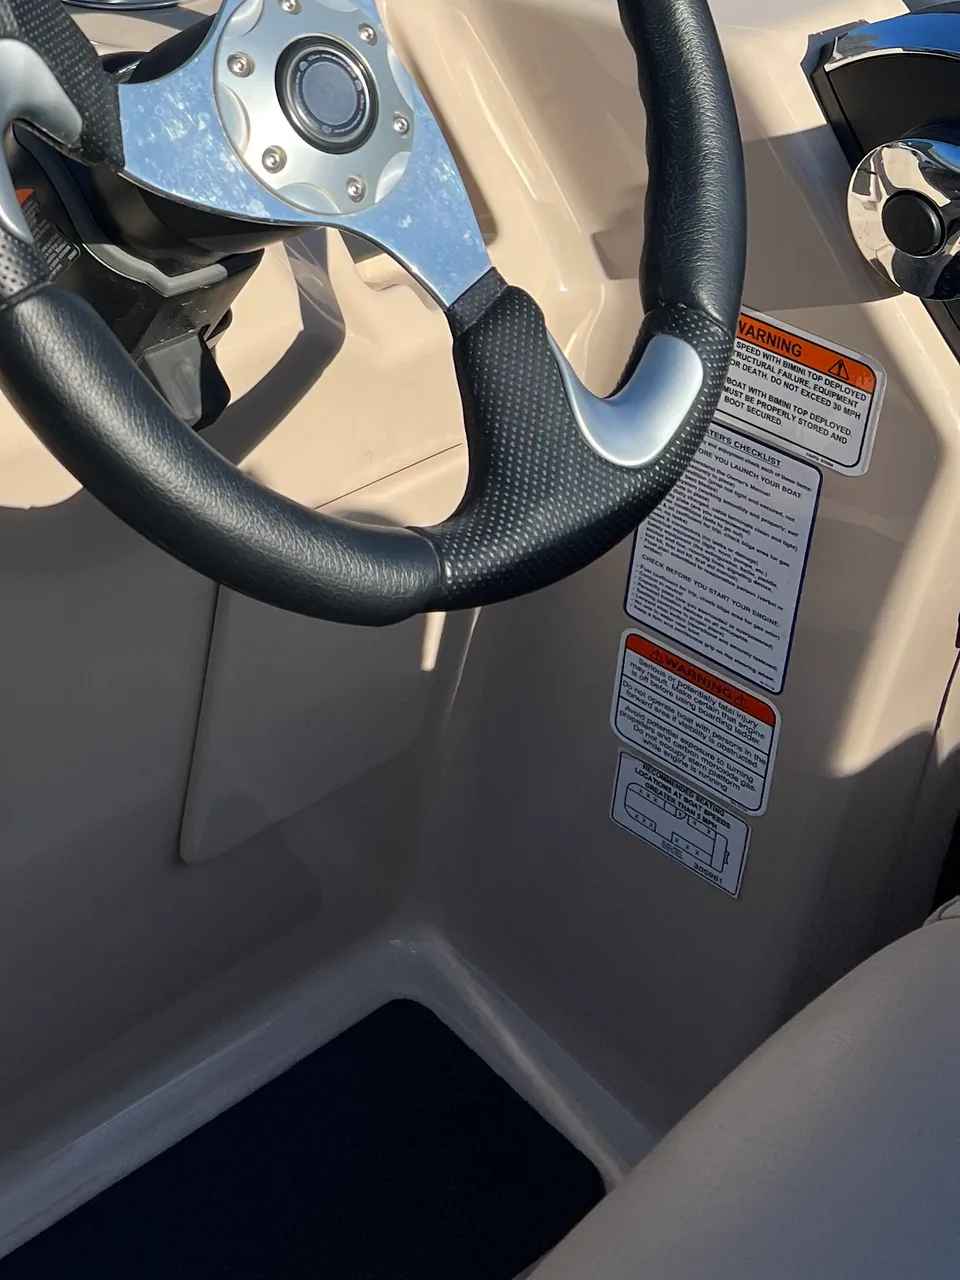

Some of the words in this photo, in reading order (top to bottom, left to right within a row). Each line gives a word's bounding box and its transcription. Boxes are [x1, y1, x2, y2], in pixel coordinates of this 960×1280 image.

[733, 350, 776, 373] TRUCTURAL
[778, 369, 811, 388] FAILURE,
[814, 384, 858, 408] EQUIPMENT
[737, 341, 760, 356] SPEED
[763, 352, 781, 365] WITH
[783, 361, 806, 376] BIMINI
[807, 371, 822, 383] TOP
[825, 379, 866, 401] DEPLOYED
[743, 364, 769, 380] DEATH.
[771, 376, 782, 385] DO
[784, 382, 798, 393] NOT
[801, 389, 831, 407] EXCEED
[833, 403, 841, 411] 30
[844, 408, 861, 419] MPH
[724, 396, 744, 409] BOOT
[746, 405, 783, 426] SECURED.
[727, 377, 745, 390] BOAT
[748, 387, 767, 399] WITH
[769, 396, 791, 410] BIMINI
[793, 406, 808, 417] TOP
[810, 413, 853, 437] DEPLOYED.
[745, 395, 755, 404] BE
[757, 400, 796, 422] PROPERLY
[798, 418, 829, 436] STORED
[831, 432, 847, 444] AND
[714, 455, 729, 465] YOU
[730, 463, 759, 479] LAUNCH
[760, 477, 780, 489] YOUR
[734, 441, 781, 466] CHECKLIST
[630, 662, 645, 674] may
[672, 684, 691, 699] Make
[694, 698, 719, 714] certain
[722, 712, 736, 723] that
[739, 722, 765, 740] engine
[639, 658, 666, 677] Serious
[678, 681, 716, 706] potentially
[737, 712, 758, 729] injury
[640, 674, 648, 682] off
[651, 680, 673, 697] before
[676, 695, 696, 711] using
[699, 708, 732, 731] boarding
[666, 657, 732, 699] WARNING
[620, 710, 655, 733] propellers
[657, 731, 671, 742] and
[674, 740, 699, 759] carbon
[702, 757, 738, 782] monoxide
[622, 680, 633, 690] Do
[635, 688, 646, 697] not
[648, 696, 675, 715] operate
[677, 711, 693, 724] boat
[696, 722, 710, 733] with
[713, 732, 742, 752] persons
[754, 754, 766, 765] the
[626, 705, 645, 720] Avoid
[647, 718, 678, 739] potential
[681, 738, 715, 761] exposure
[717, 757, 725, 766] to
[727, 764, 753, 784] turning
[633, 724, 644, 734] Do
[646, 732, 657, 742] not
[659, 740, 686, 760] occupy
[709, 769, 740, 790] platform
[643, 738, 661, 752] while
[664, 751, 687, 768] engine
[699, 771, 727, 792] running
[635, 768, 672, 794] LOCATIONS
[673, 791, 682, 800] AT
[684, 797, 701, 811] BOAT
[645, 782, 675, 804] GREATER
[678, 802, 695, 816] THAN
